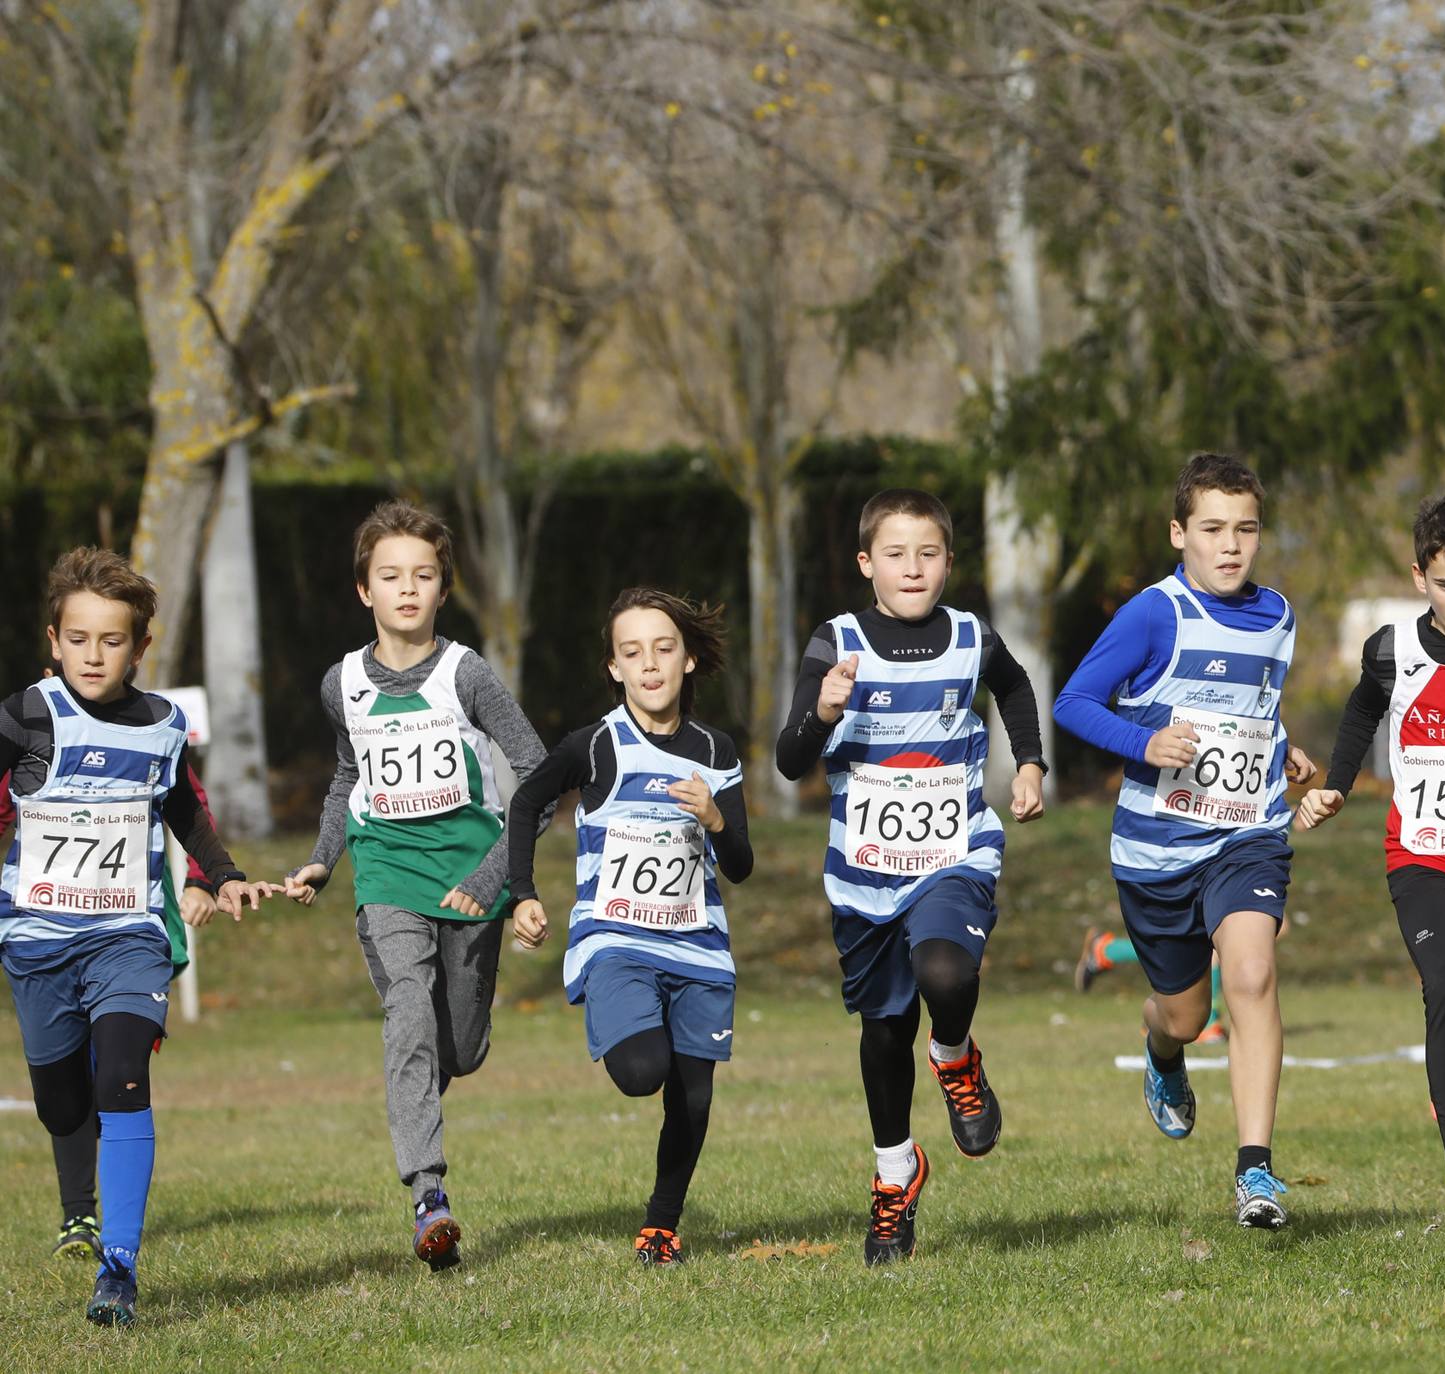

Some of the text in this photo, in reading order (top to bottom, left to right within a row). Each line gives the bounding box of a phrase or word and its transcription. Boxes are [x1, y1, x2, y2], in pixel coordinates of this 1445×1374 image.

[1204, 660, 1227, 673] AS
[867, 691, 892, 704] AS
[351, 715, 455, 737] Gobierno de La Rioja
[1238, 730, 1248, 739] de
[82, 751, 106, 765] AS
[361, 739, 458, 787] 1513
[1403, 755, 1445, 767] Gobierno
[853, 772, 964, 788] Gobierno de La Rioja
[392, 792, 461, 814] ATLETISMO
[22, 810, 146, 826] Gobierno de La Rioja
[853, 797, 961, 843] 1633
[1193, 803, 1257, 824] ATLETISMO
[608, 828, 652, 844] Gobierno
[672, 835, 683, 844] de
[42, 834, 128, 879] 774
[883, 854, 957, 871] ATLETISMO
[609, 853, 702, 897] 1627
[57, 892, 136, 910] ATLETISMO
[633, 908, 698, 926] ATLETISMO
